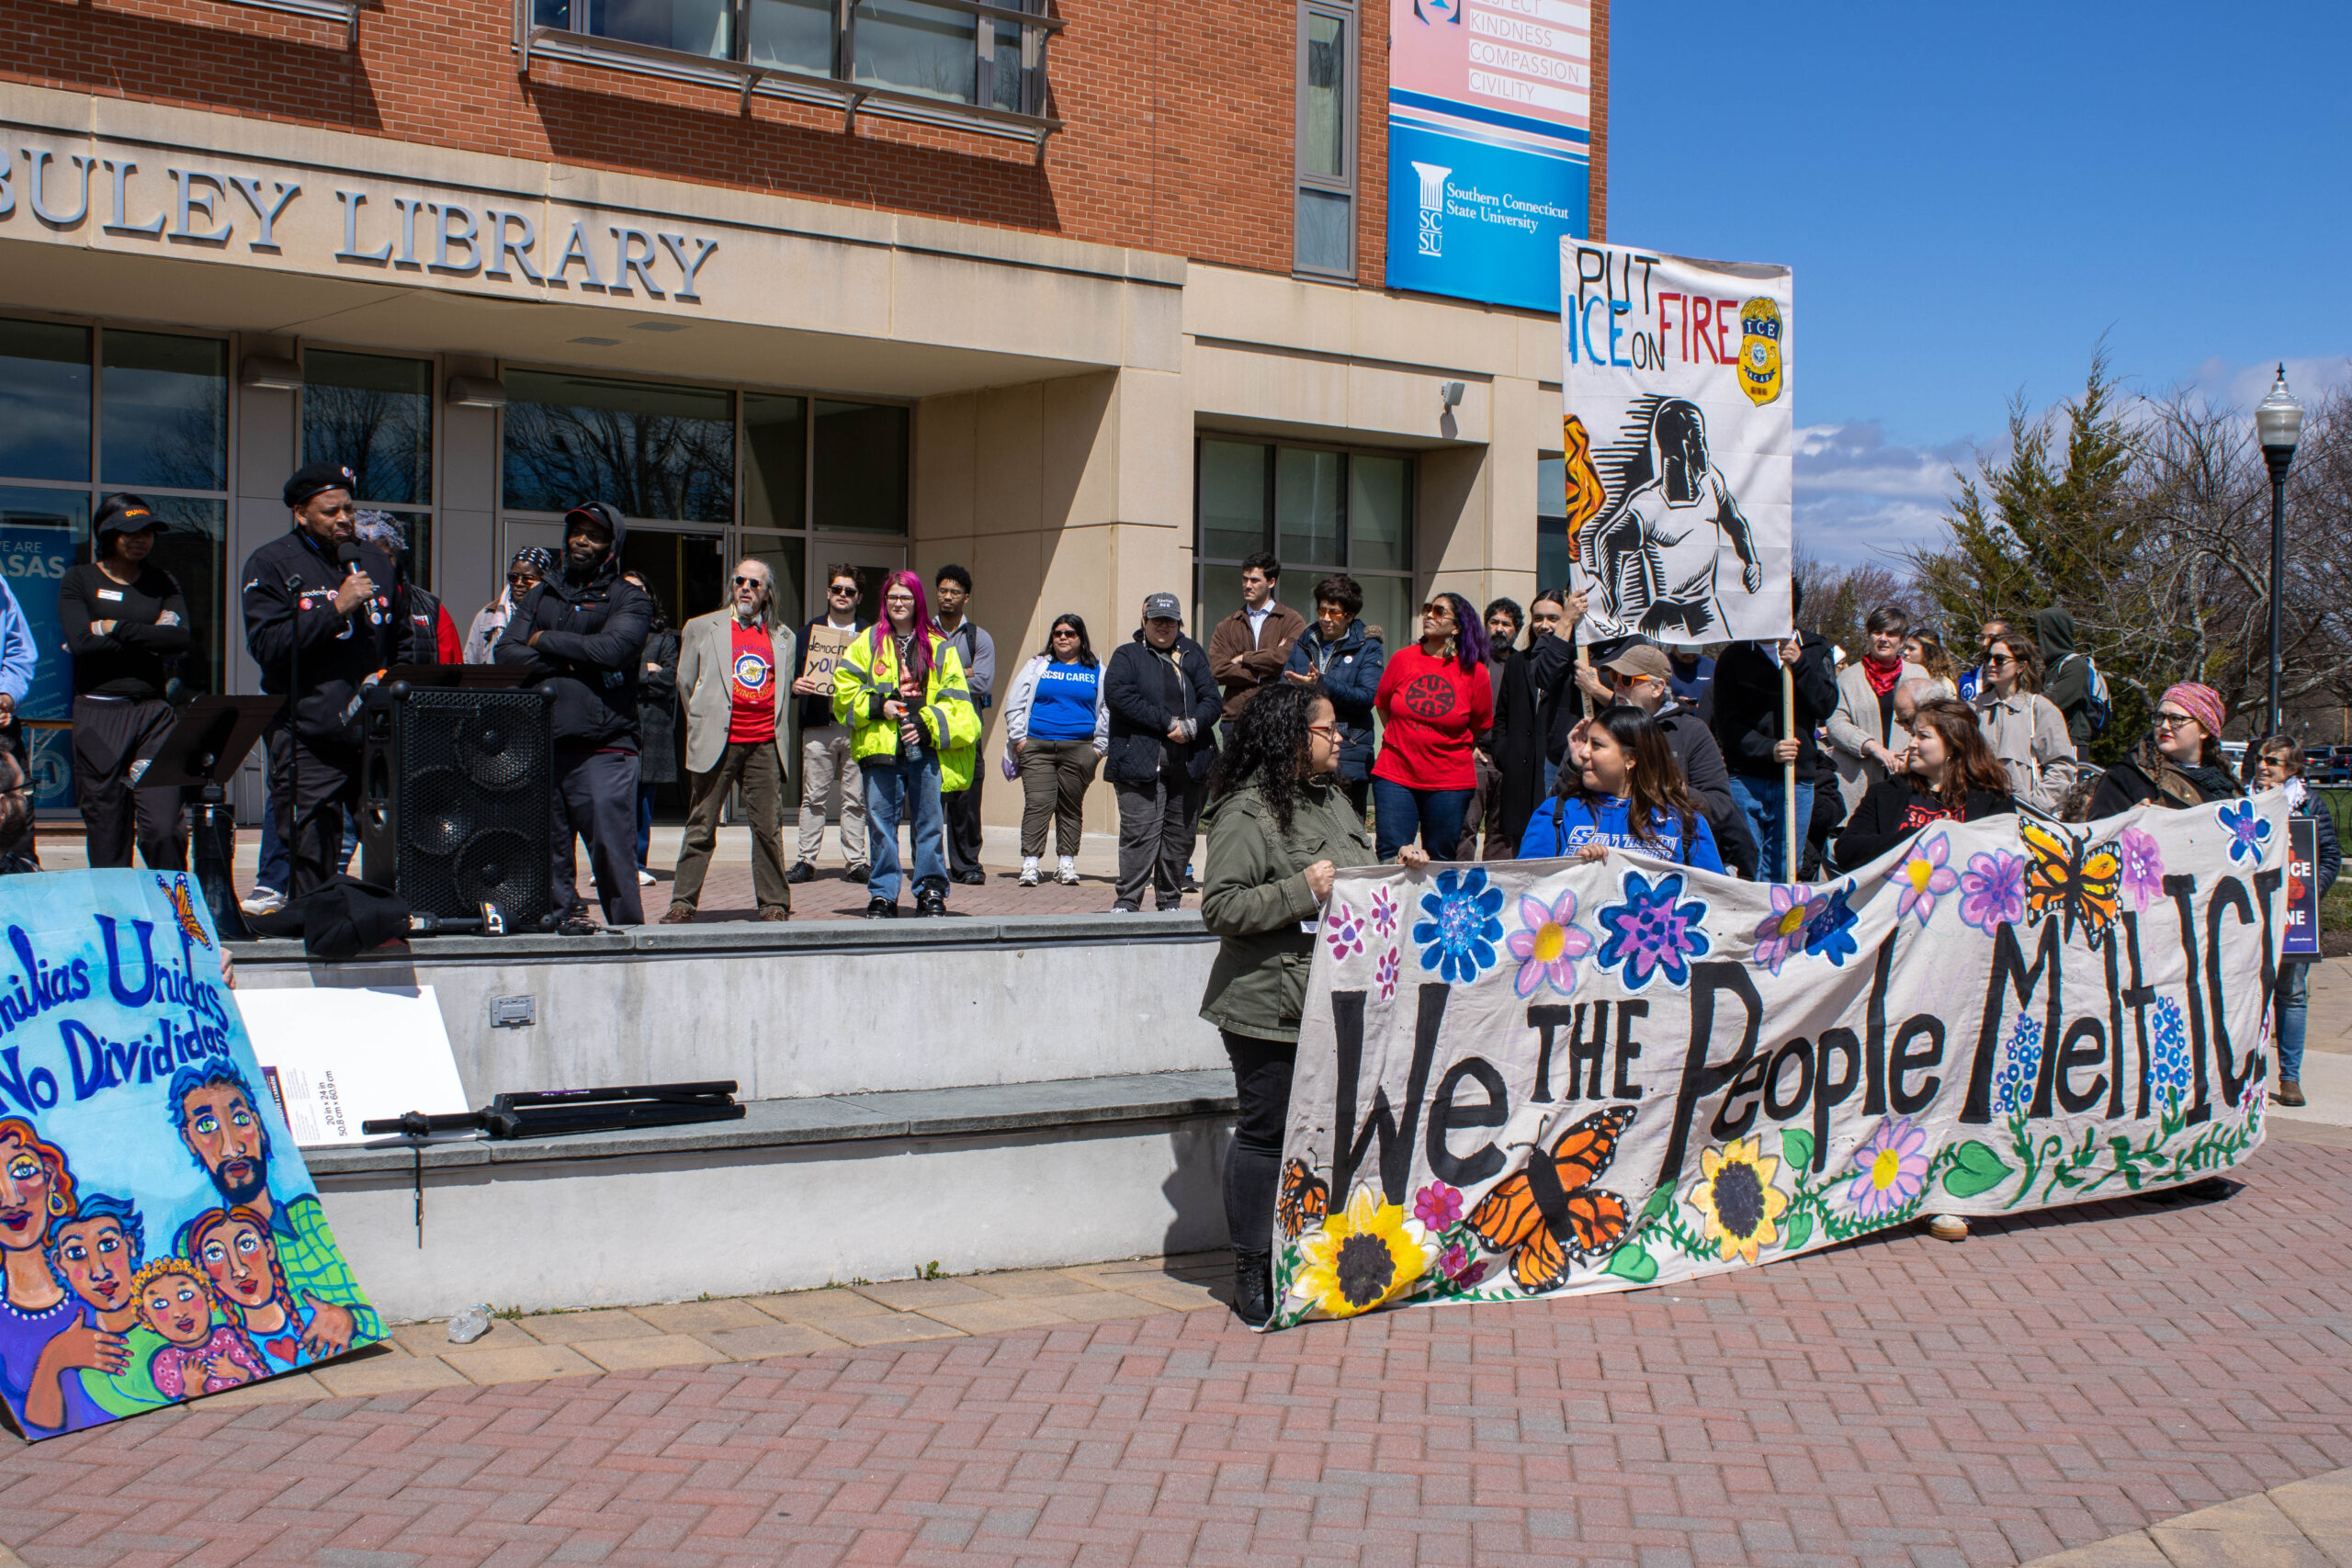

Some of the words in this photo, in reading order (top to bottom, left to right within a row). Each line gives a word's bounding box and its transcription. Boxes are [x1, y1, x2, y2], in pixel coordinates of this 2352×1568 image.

[1471, 11, 1552, 48] KINDNESS
[1470, 42, 1579, 84] COMPASSION
[1470, 72, 1535, 102] CIVILITY
[1446, 182, 1499, 208] Southern
[1502, 193, 1569, 220] Connecticut
[1419, 209, 1443, 231] SC
[1446, 199, 1476, 220] State
[1481, 206, 1539, 234] University
[334, 189, 718, 302] LIBRARY
[1419, 231, 1443, 253] SU
[1577, 247, 1661, 316] PUT
[1568, 294, 1633, 367] ICE
[1632, 331, 1665, 372] ON
[1658, 292, 1740, 366] FIRE
[1747, 321, 1775, 338] ICE
[14, 541, 43, 554] ARE
[808, 635, 847, 656] democr
[1041, 670, 1065, 681] SCSU
[1066, 672, 1096, 684] CARES
[93, 912, 229, 1033] Unidas
[0, 1044, 59, 1117] No
[58, 1009, 231, 1102] Divididas
[1330, 982, 1510, 1216] We
[1526, 998, 1650, 1104] THE
[1656, 926, 1947, 1189] People
[1958, 910, 2157, 1126] Melt
[325, 1070, 334, 1083] cm
[319, 1090, 330, 1100] 24
[327, 1083, 339, 1101] 60.9
[325, 1114, 335, 1126] 20
[334, 1106, 344, 1119] cm
[335, 1119, 348, 1137] 50.8
